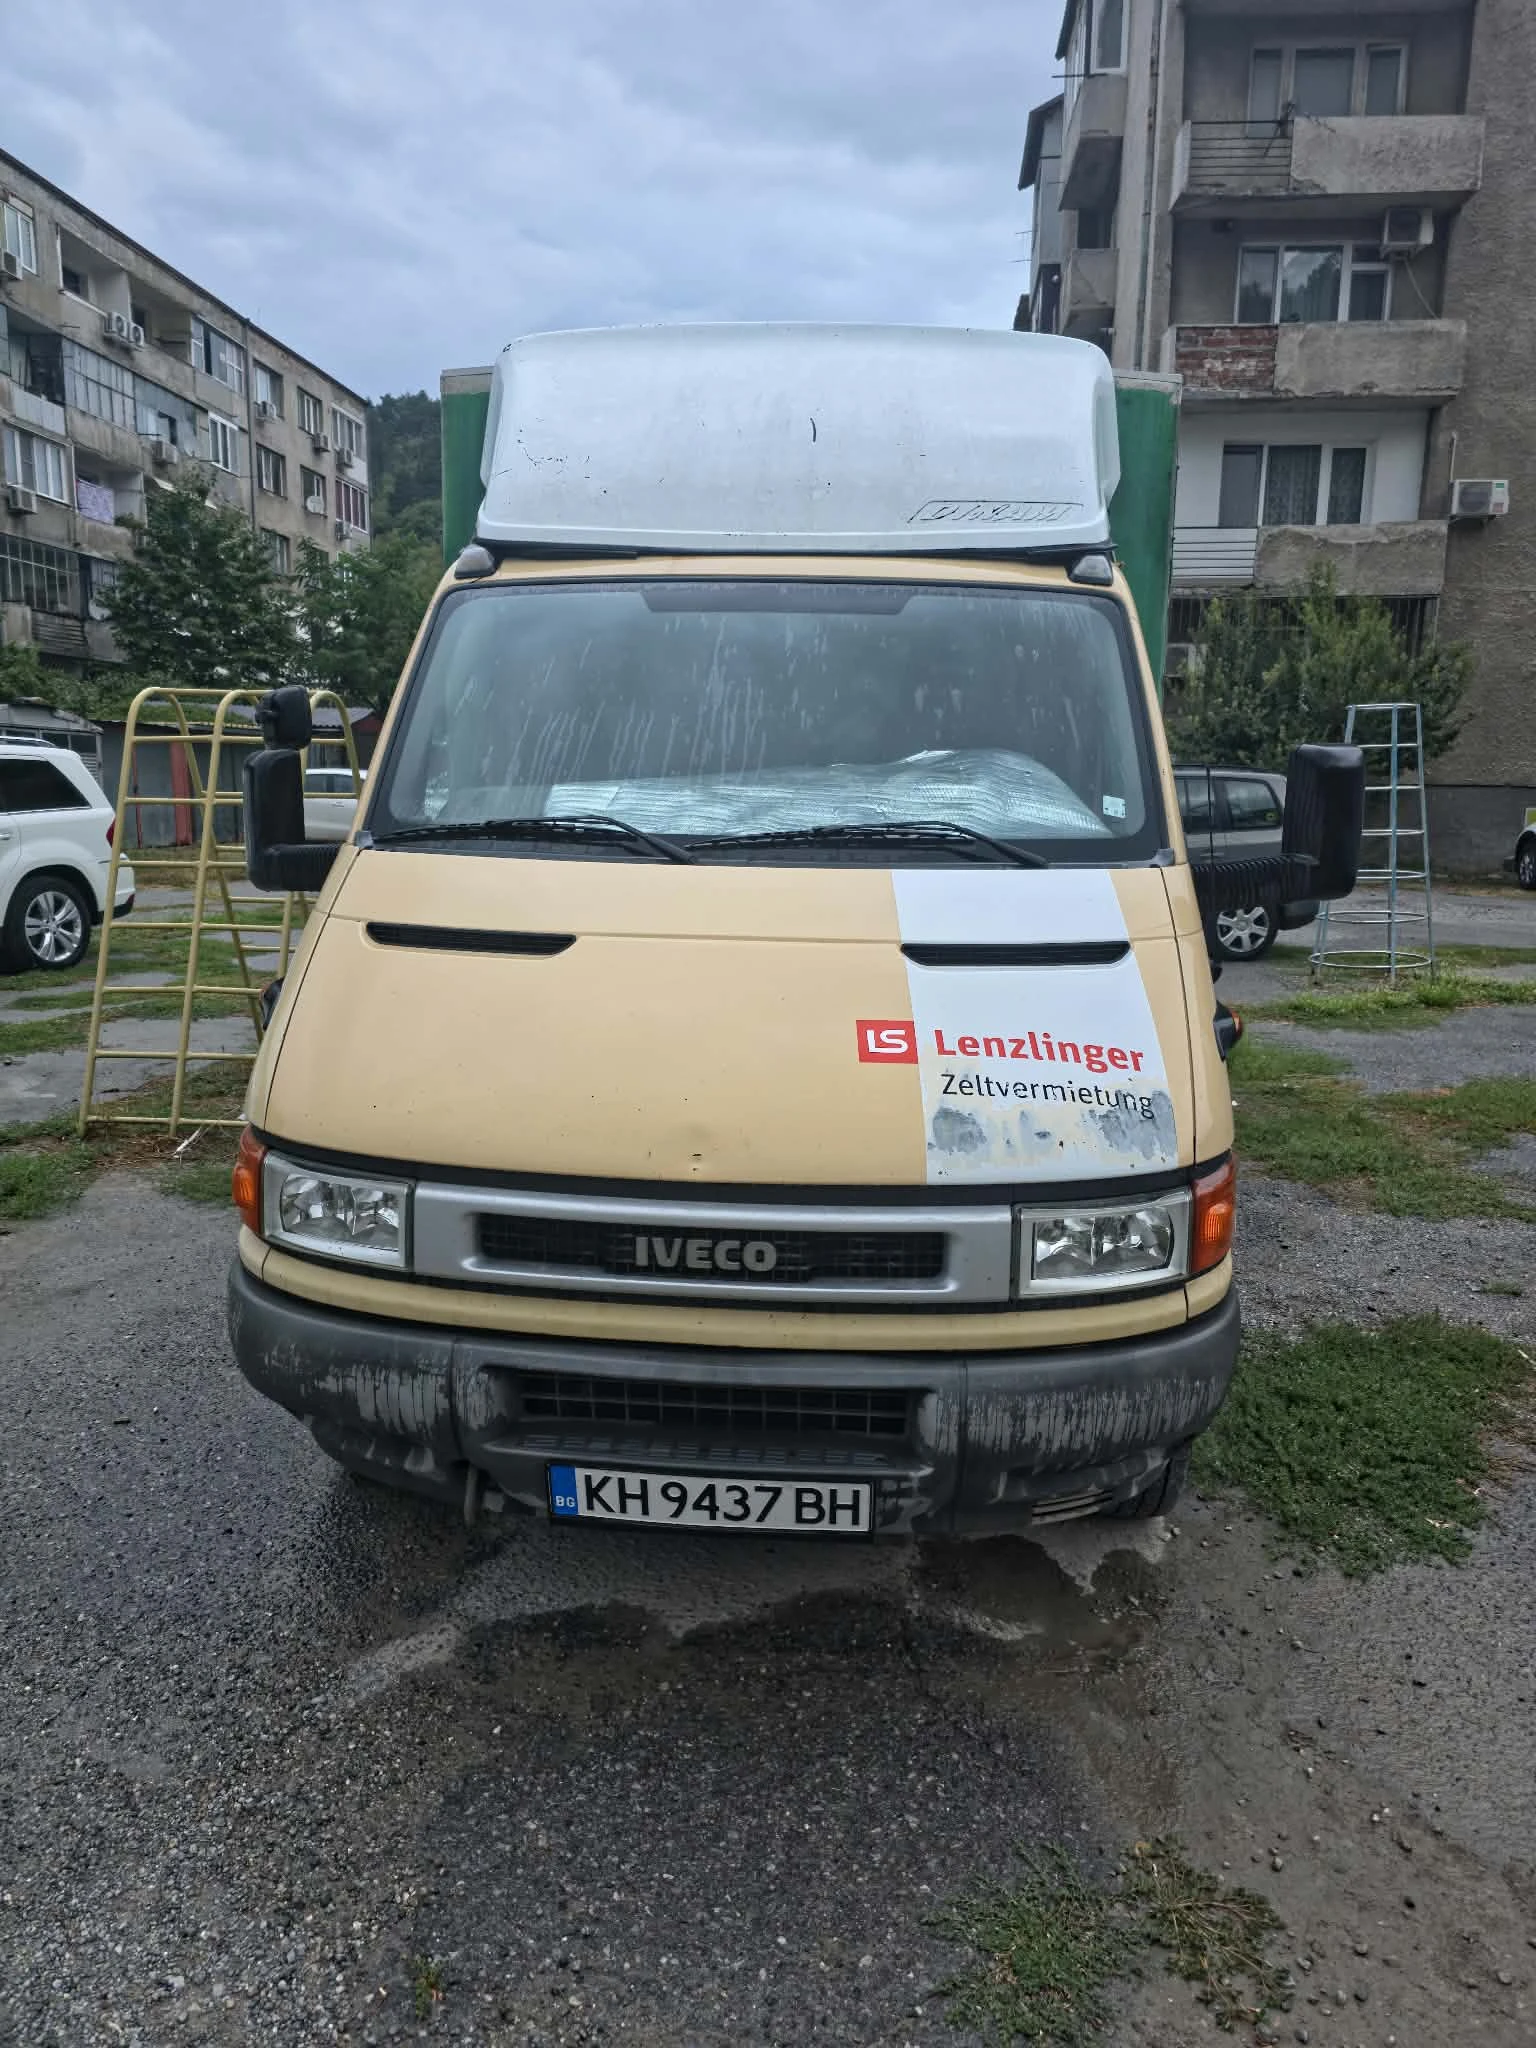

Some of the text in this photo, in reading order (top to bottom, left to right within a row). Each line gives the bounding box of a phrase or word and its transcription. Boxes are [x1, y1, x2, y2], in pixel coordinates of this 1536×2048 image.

[866, 1028, 909, 1054] LS
[933, 1029, 1144, 1074] Lenzlinger
[940, 1073, 1154, 1120] Zeltvermietung
[634, 1236, 777, 1272] IVECO
[555, 1495, 577, 1508] BG
